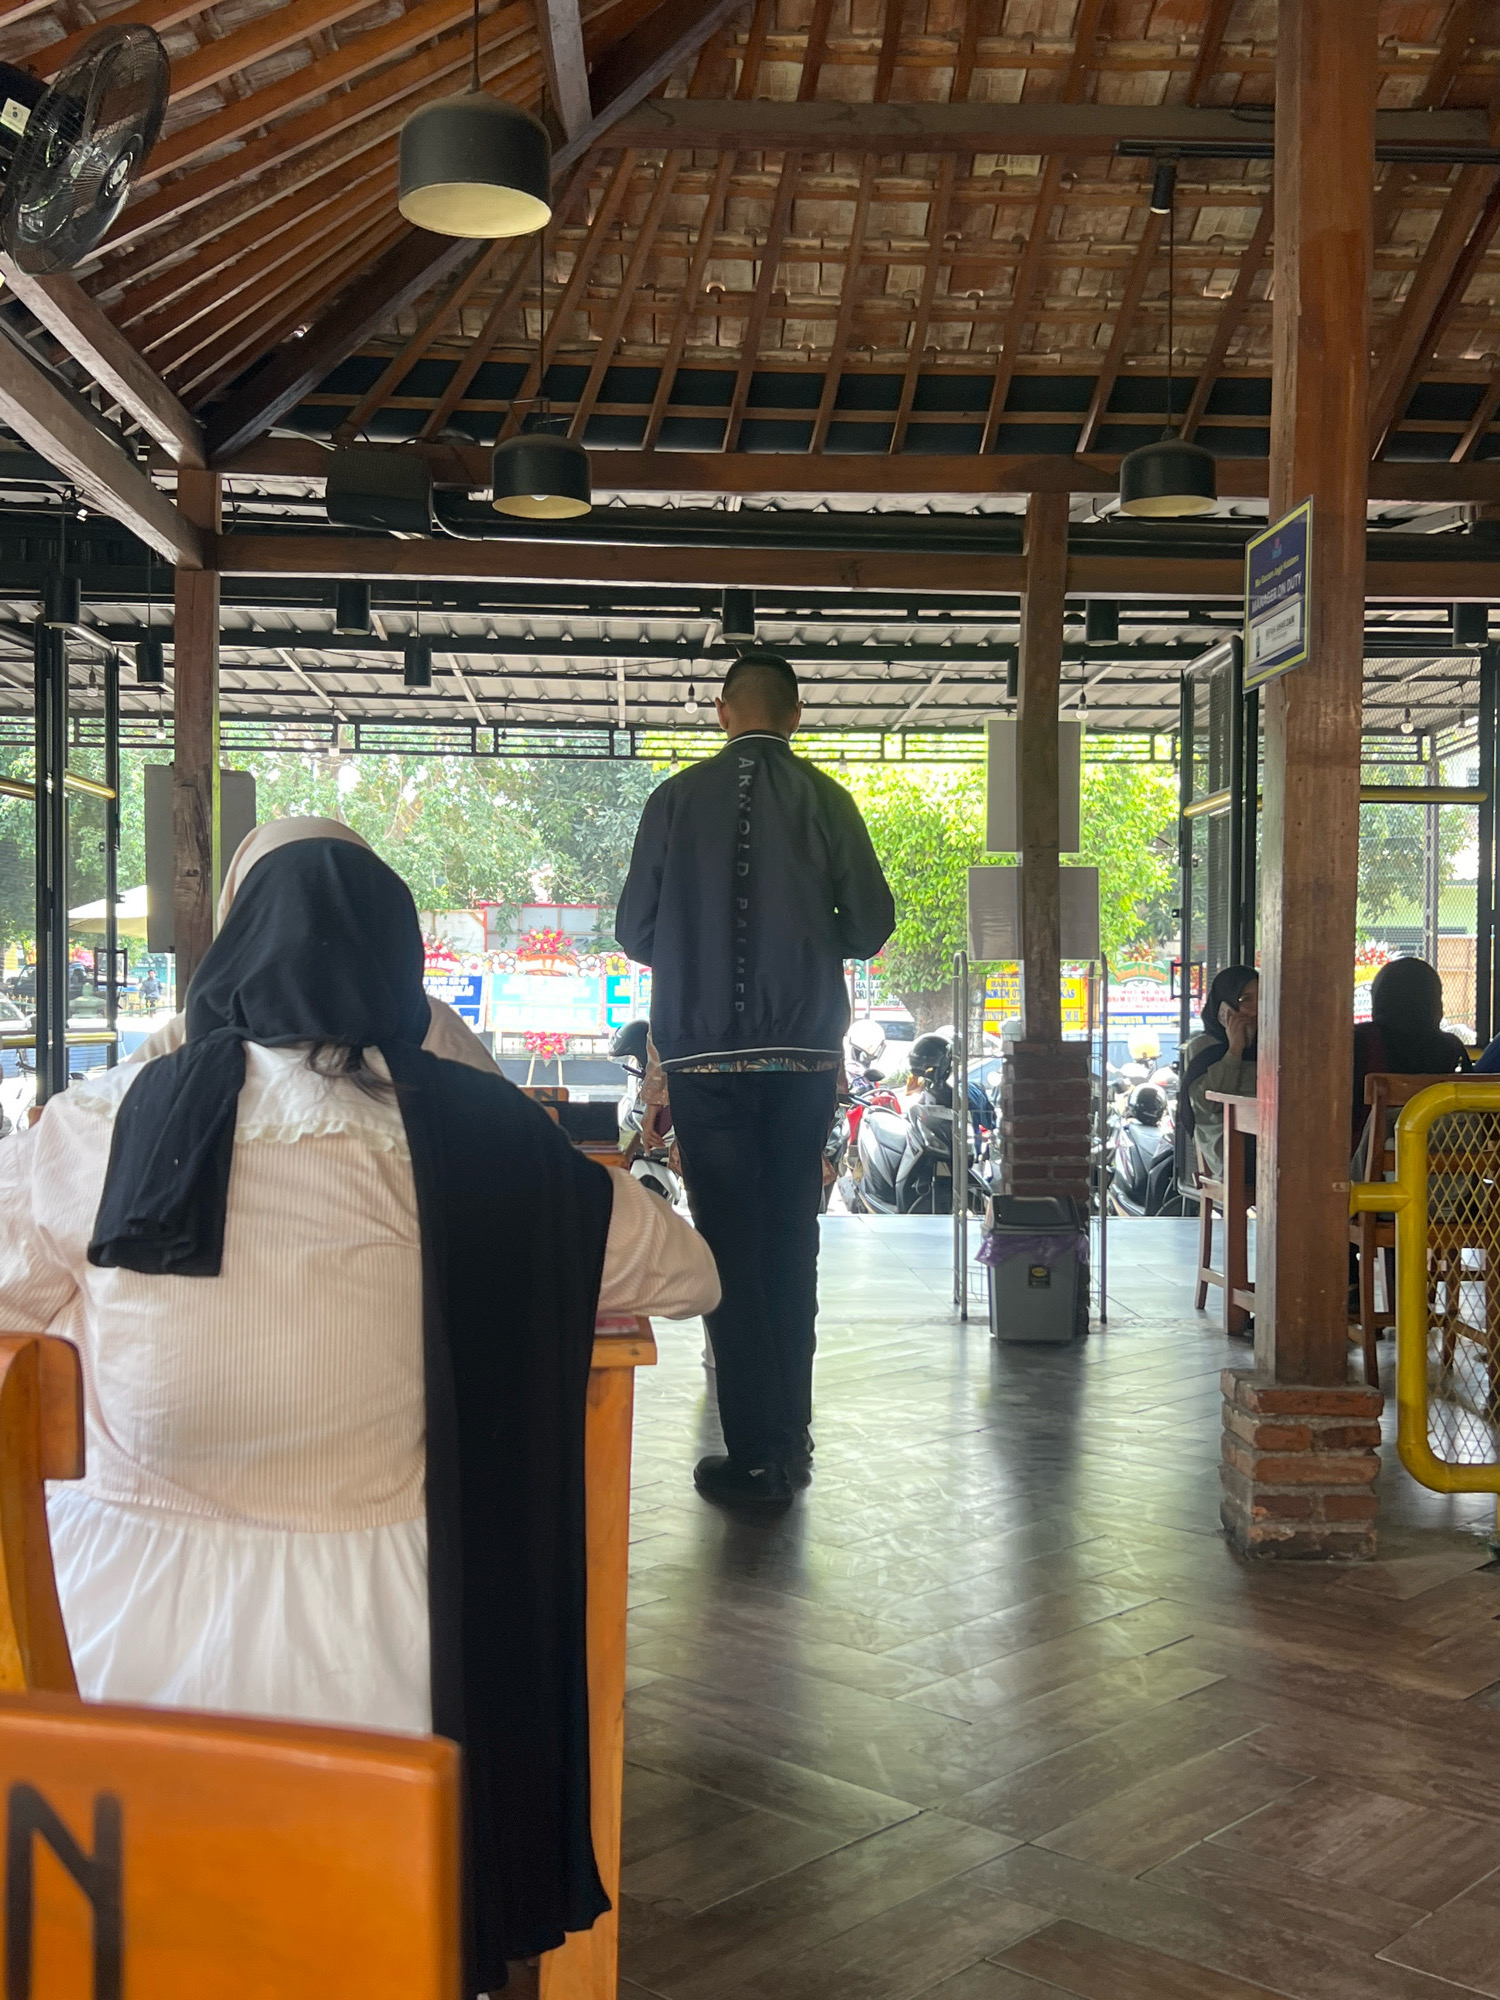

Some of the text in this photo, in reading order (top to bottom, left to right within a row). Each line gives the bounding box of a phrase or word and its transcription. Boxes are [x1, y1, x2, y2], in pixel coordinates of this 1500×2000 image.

[1277, 581, 1287, 598] ON
[1286, 571, 1302, 592] DUTY
[738, 757, 755, 877] ARNOLD
